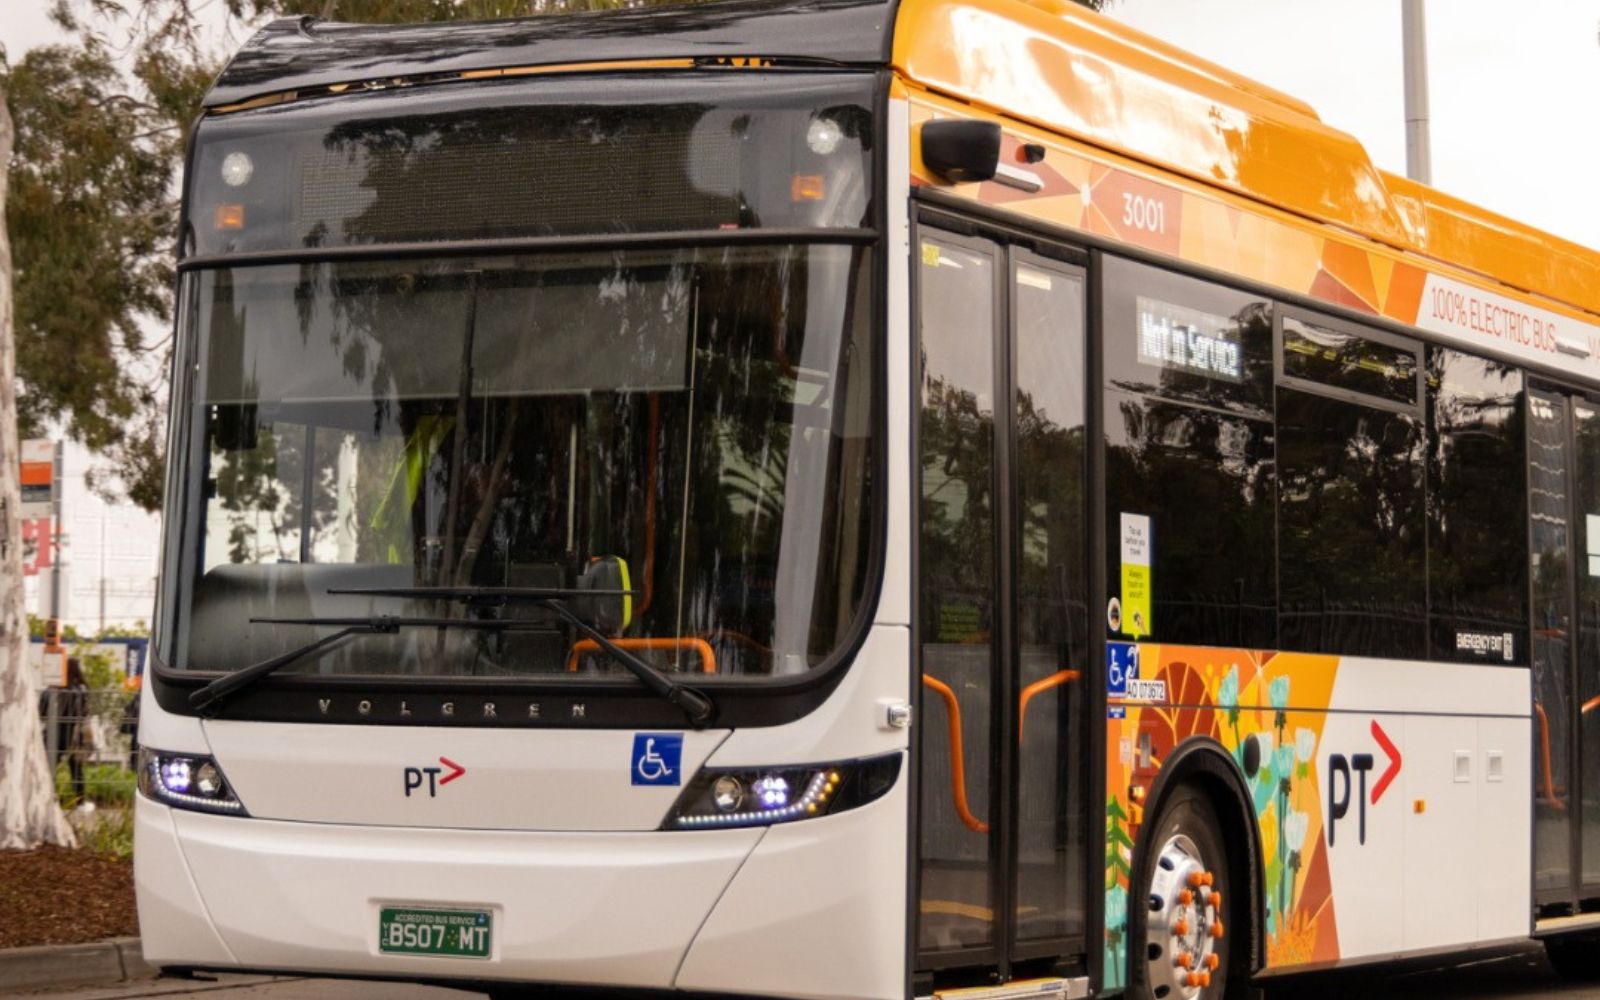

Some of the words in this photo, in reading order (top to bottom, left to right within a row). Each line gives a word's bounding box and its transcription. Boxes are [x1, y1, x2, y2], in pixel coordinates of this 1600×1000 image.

[1122, 191, 1165, 235] 3001
[1432, 286, 1467, 327] 100%
[1470, 297, 1530, 346] ELECTRIC
[1533, 319, 1556, 353] BUS
[1141, 311, 1169, 360] Not
[1171, 319, 1186, 366] in
[1187, 324, 1239, 377] Service
[1456, 633, 1489, 650] EMERGENCY
[1491, 635, 1503, 651] EXIT
[319, 698, 586, 718] VOLGREN
[404, 767, 442, 797] PT
[1328, 753, 1374, 848] PT
[394, 913, 434, 923] ACCREDITED
[435, 915, 448, 924] BUS
[449, 916, 476, 925] SERVICE
[459, 926, 488, 951] MT
